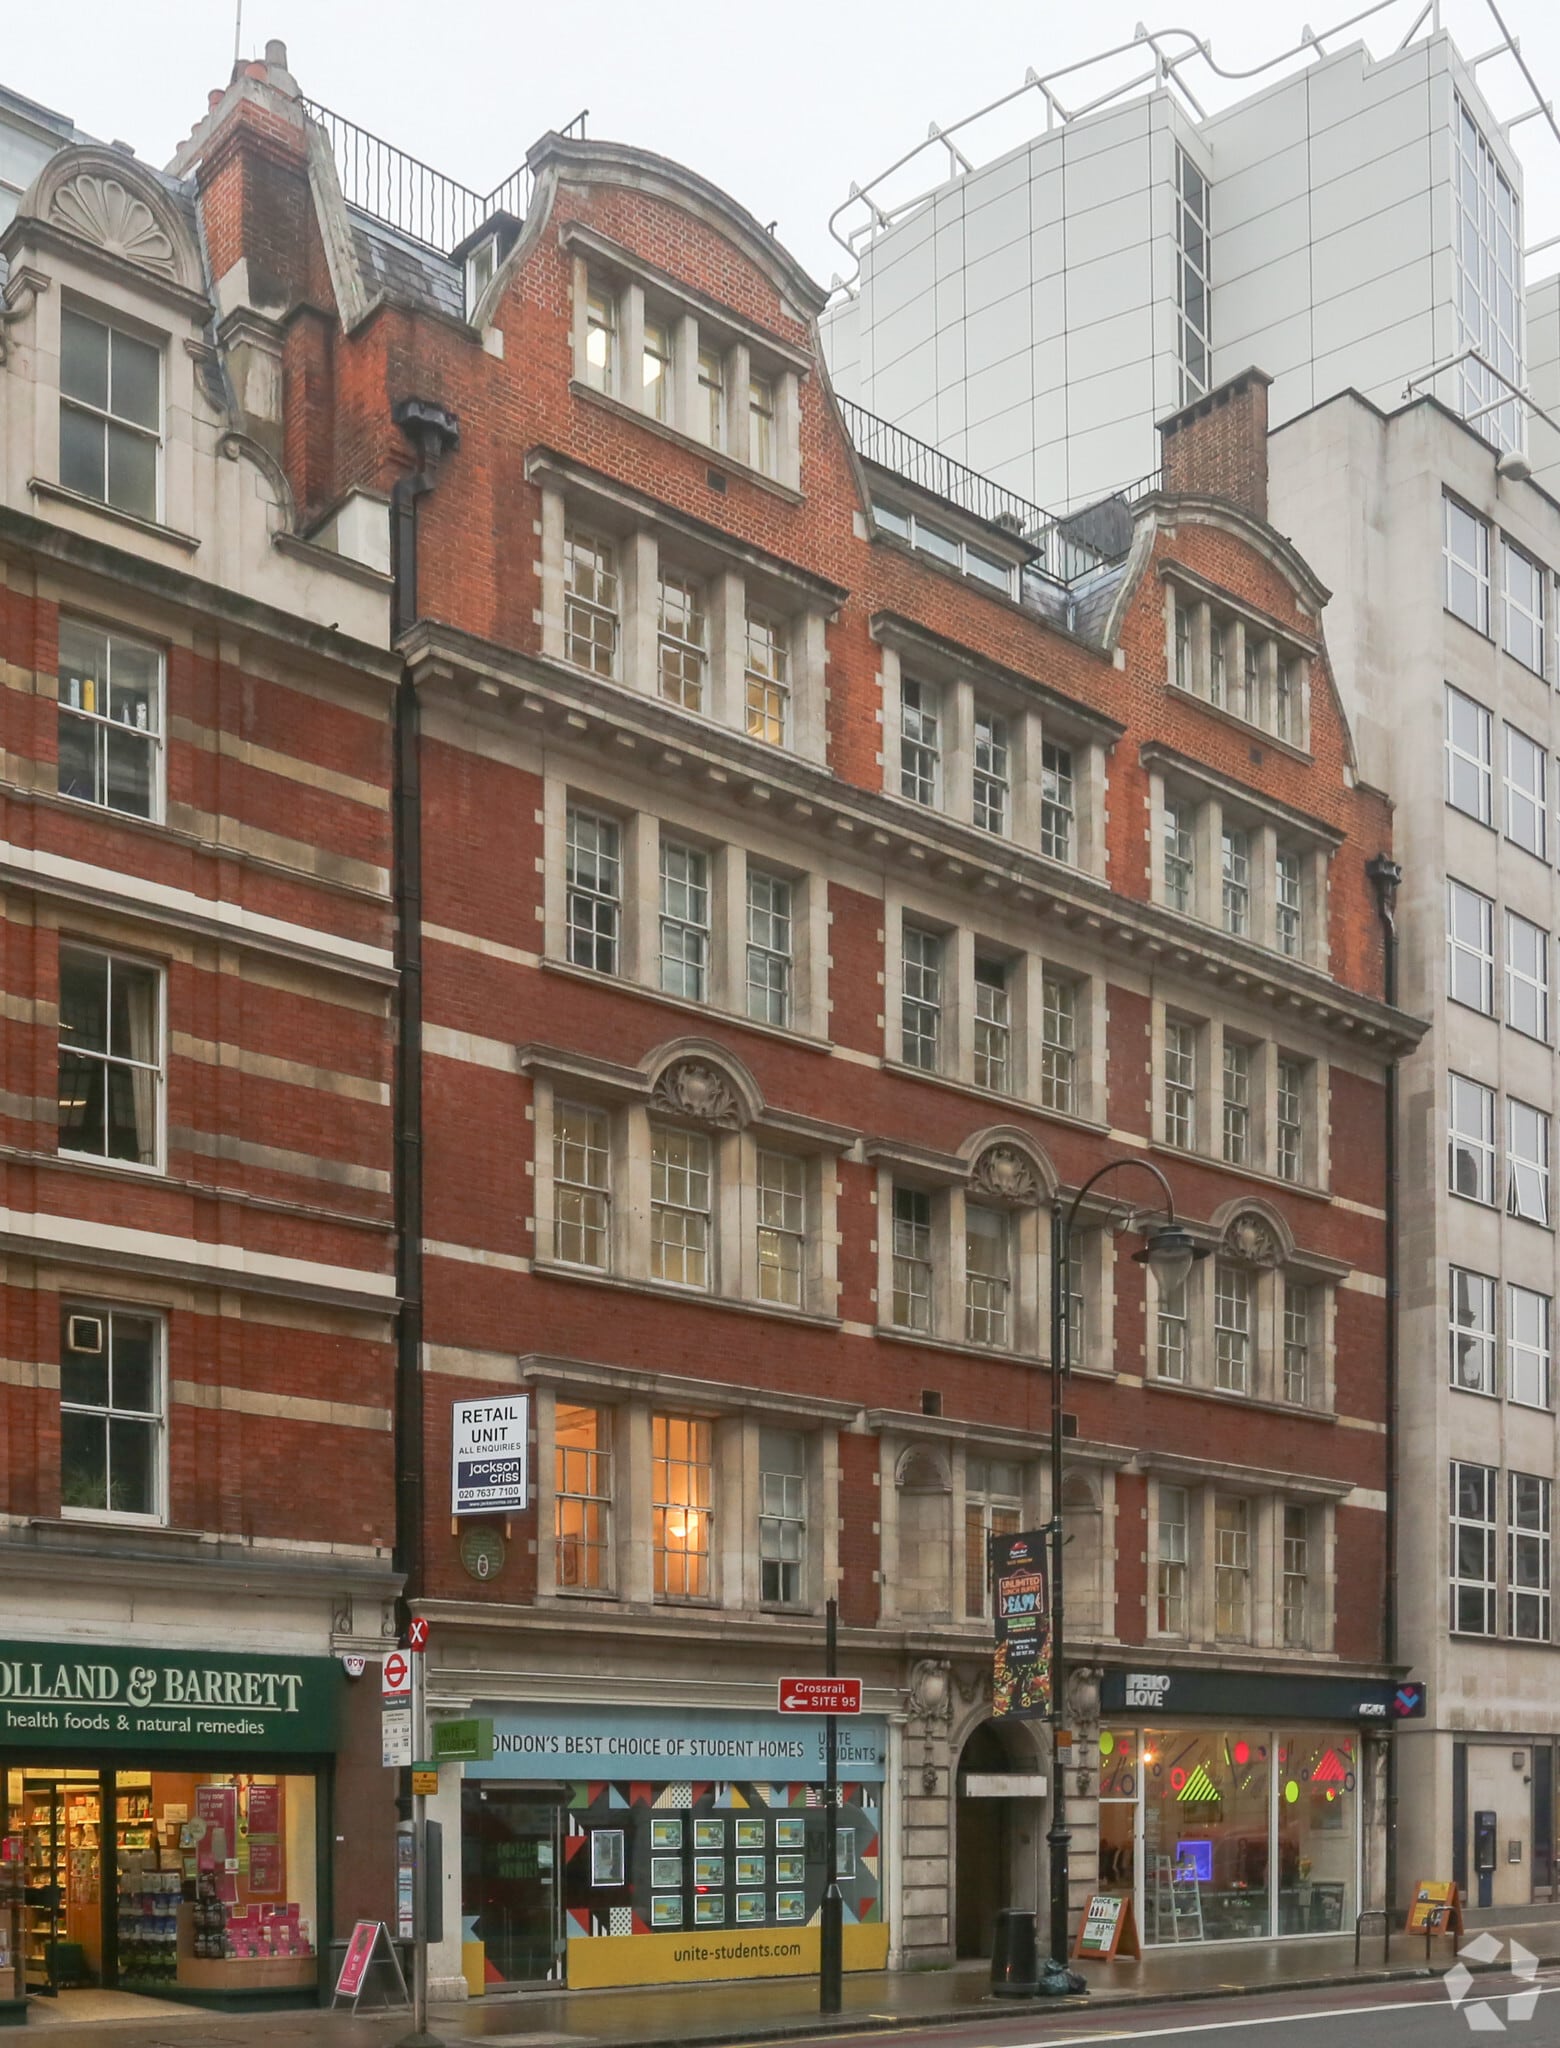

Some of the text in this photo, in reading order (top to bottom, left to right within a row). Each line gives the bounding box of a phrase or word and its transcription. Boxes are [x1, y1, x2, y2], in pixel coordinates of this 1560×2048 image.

[462, 1406, 518, 1424] RETAIL
[471, 1427, 508, 1443] UNIT
[459, 1442, 521, 1454] ALL ENQUIRIES
[489, 1471, 519, 1484] criss
[458, 1486, 519, 1499] 020 7637 7100
[1002, 1576, 1040, 1589] UNLIMITED
[411, 1622, 423, 1643] X
[127, 1666, 157, 1707] &
[163, 1668, 303, 1712] BARRETT
[795, 1683, 846, 1693] Crossrail
[811, 1696, 857, 1707] SITE 95
[1126, 1689, 1163, 1706] LOVE
[7, 1710, 265, 1734] health foods & natural remedies
[493, 1734, 804, 1757] ONDON'S BEST CHOICE OF STUDENT HOMES
[818, 1731, 851, 1745] UTE
[818, 1746, 876, 1761] SDENTS
[674, 1942, 801, 1962] unite-students.com
